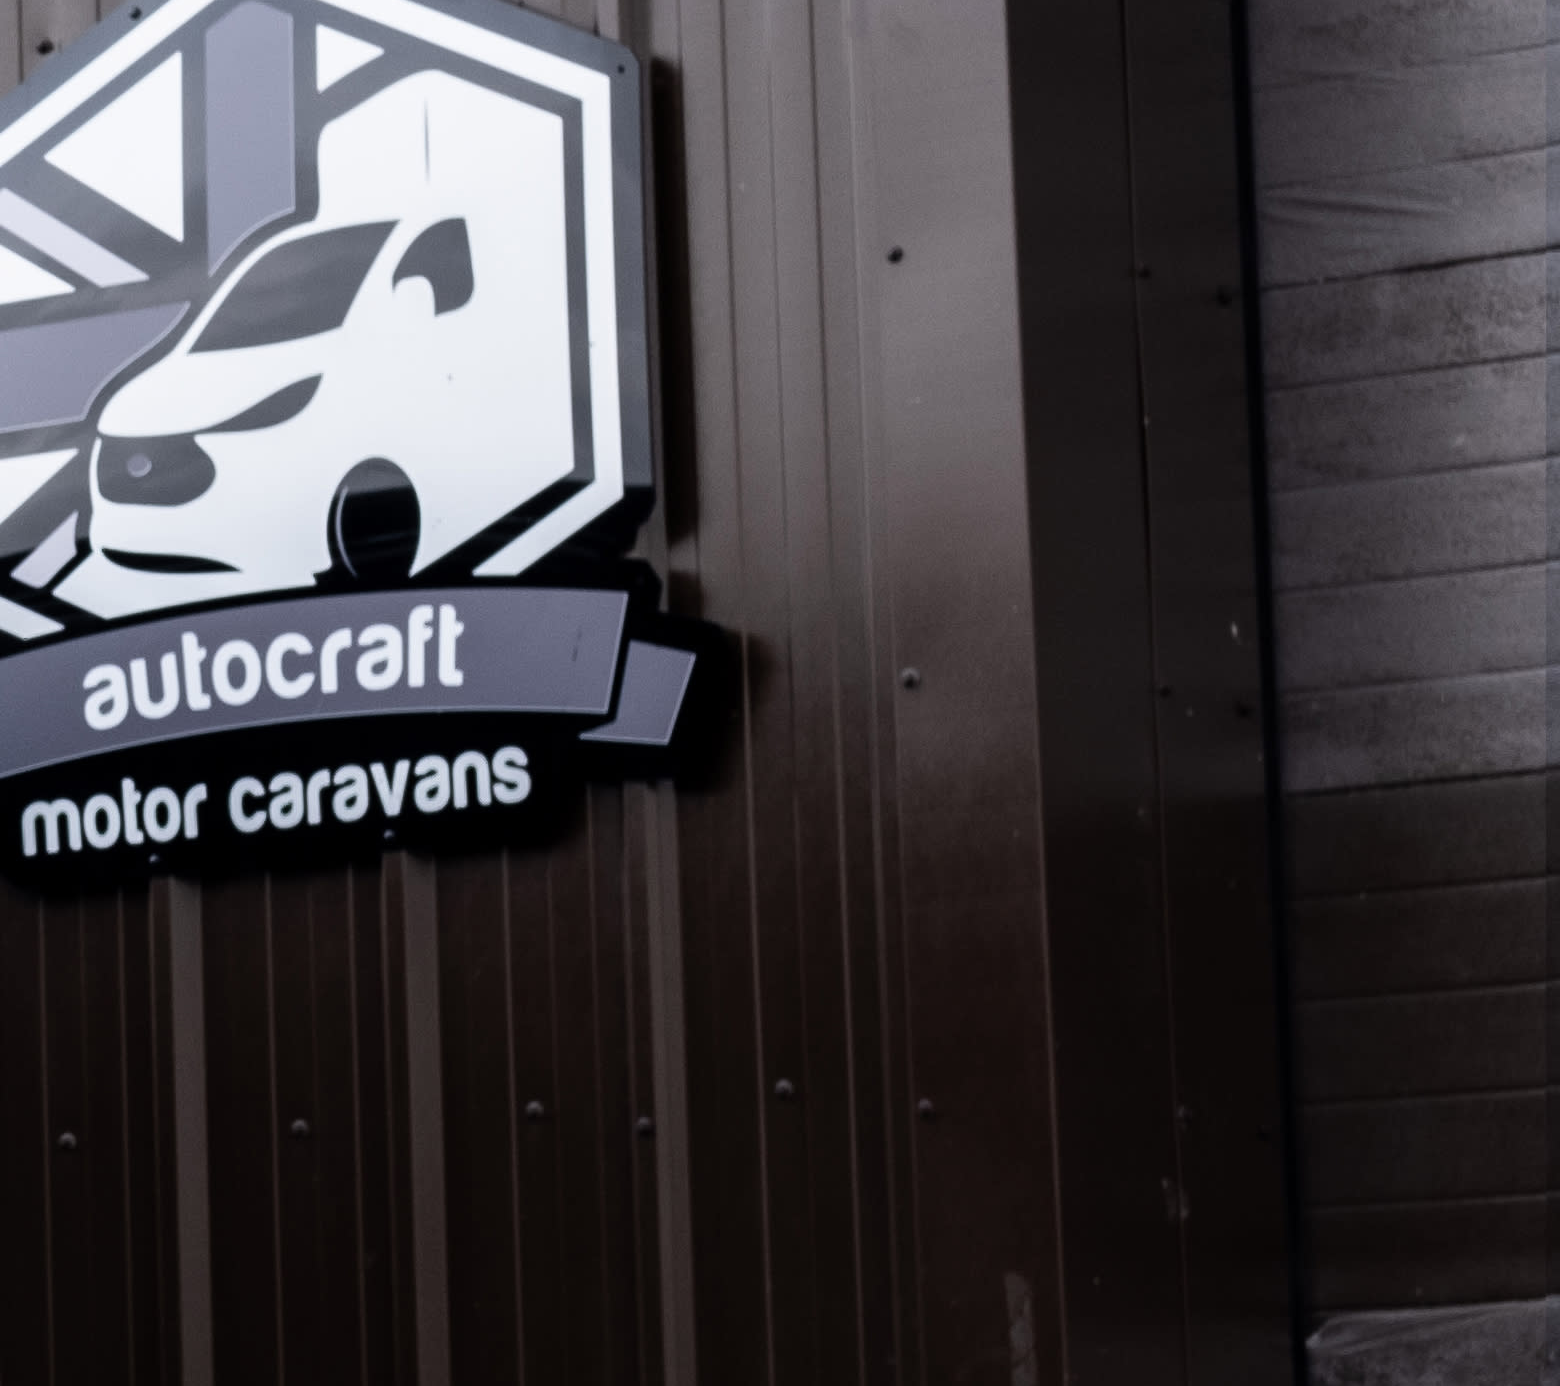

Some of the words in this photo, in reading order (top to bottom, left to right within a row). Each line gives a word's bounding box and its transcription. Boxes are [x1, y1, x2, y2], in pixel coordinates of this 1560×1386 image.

[82, 605, 464, 730] autocraft
[21, 778, 207, 856] motor
[228, 745, 532, 834] caravans
